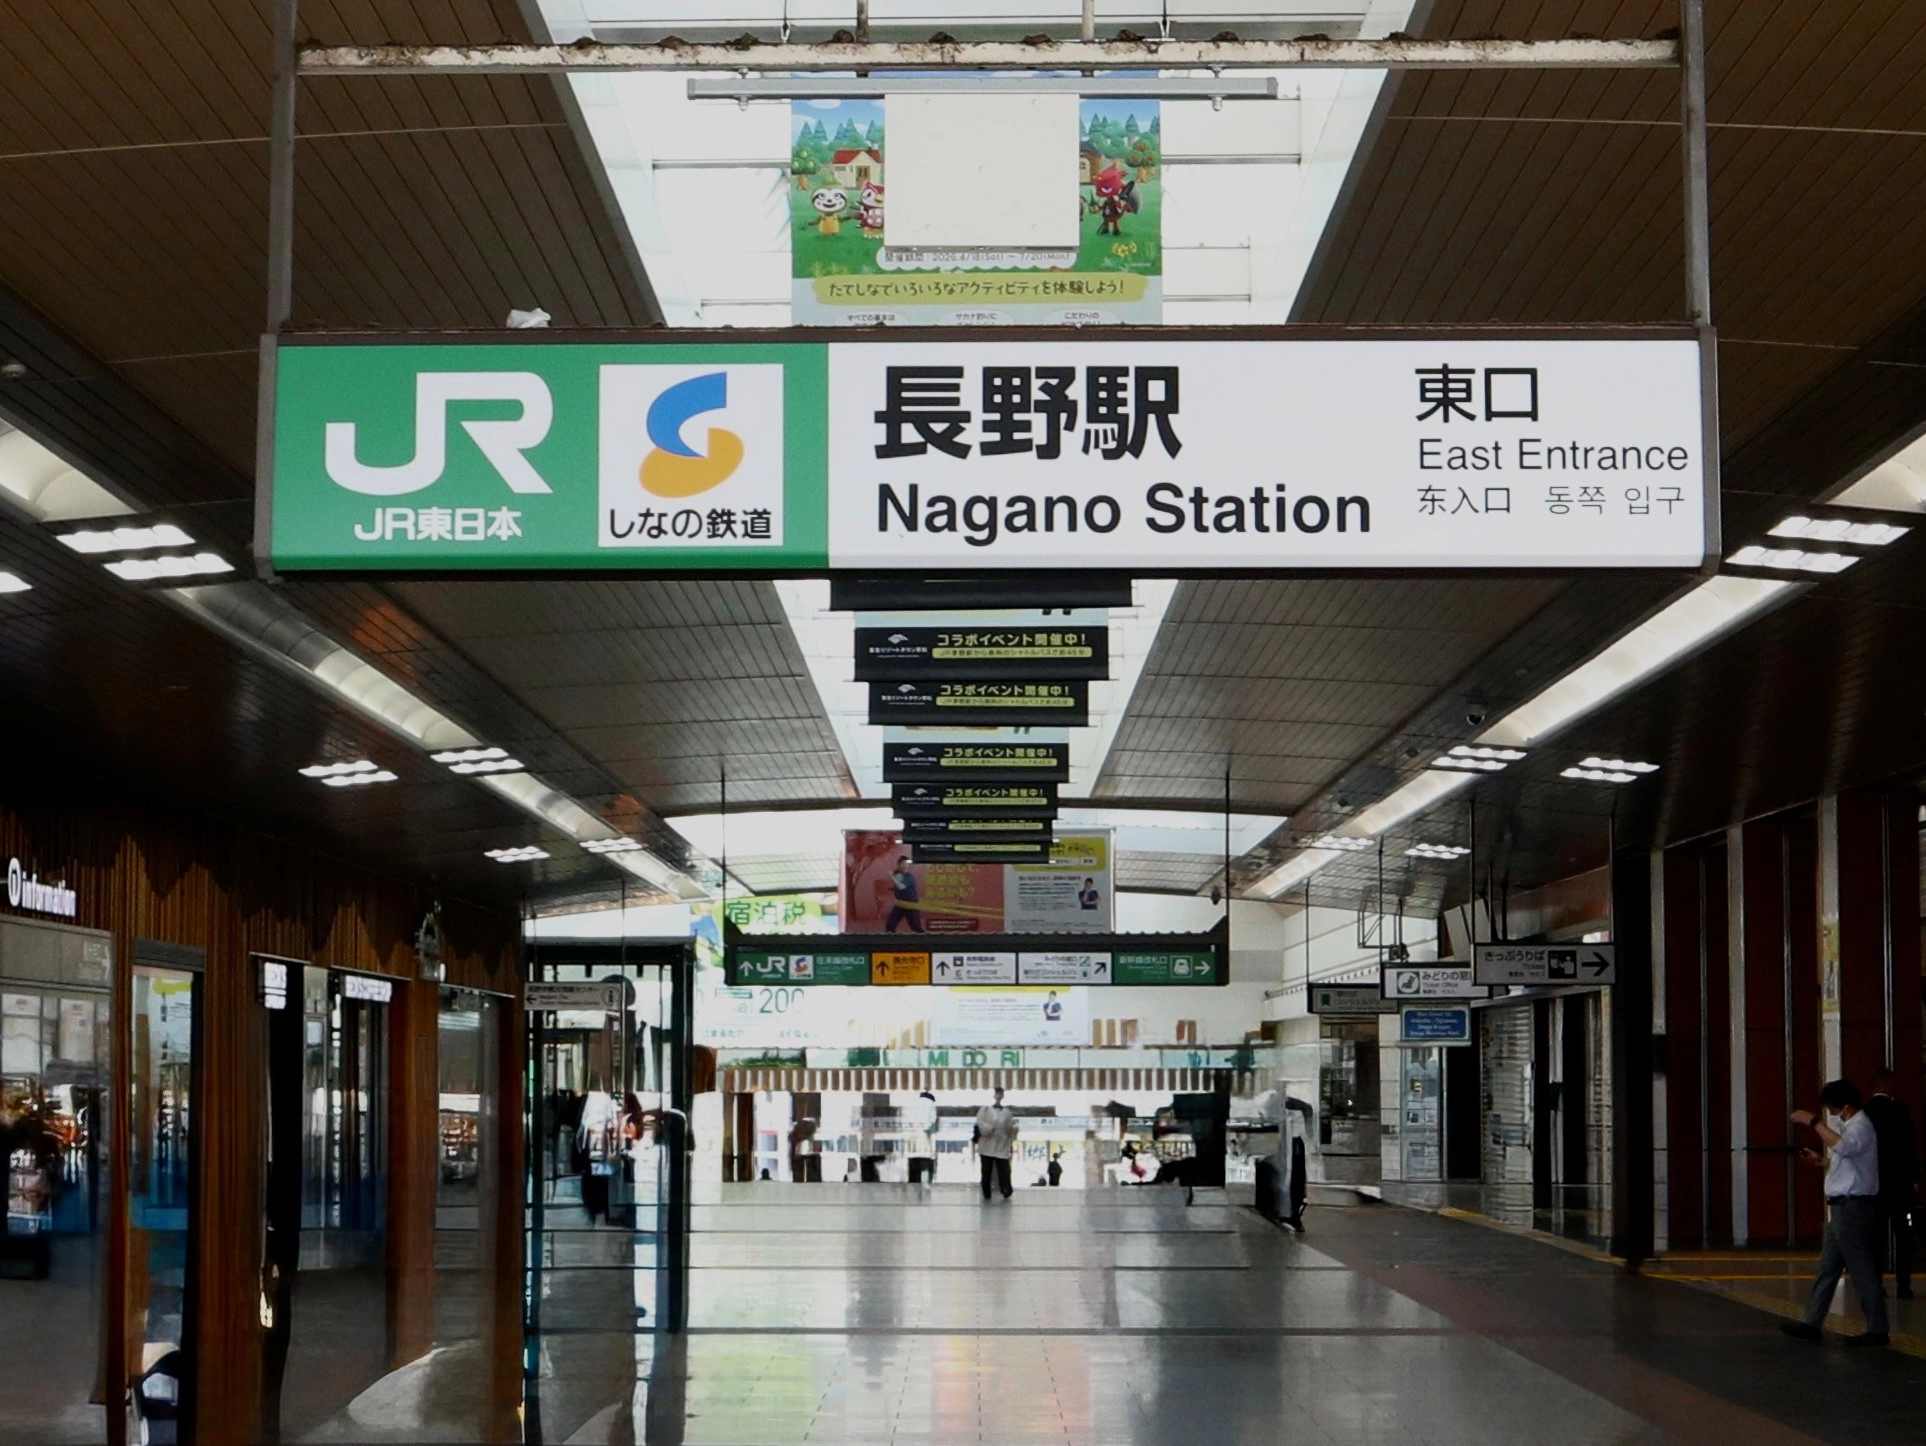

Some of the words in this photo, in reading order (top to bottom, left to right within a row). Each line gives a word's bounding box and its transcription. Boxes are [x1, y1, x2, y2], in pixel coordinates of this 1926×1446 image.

[829, 280, 1125, 298] たてしなでいろいろなアクティビティを体験しよう！
[1415, 363, 1539, 423] 東口
[874, 365, 1183, 460] 長野駅
[325, 371, 554, 496] JR
[1419, 439, 1503, 471] East
[1518, 439, 1689, 472] Entrance
[877, 482, 1122, 547] Nagano
[1145, 482, 1371, 534] Station
[1417, 484, 1512, 515] 东入口
[1544, 485, 1607, 515] 동쪽
[1624, 485, 1685, 515] 입구
[354, 506, 523, 541] JR東日本
[608, 507, 773, 540] しなの鉄道
[726, 900, 806, 925] 宿泊税
[756, 956, 787, 973] JR
[1484, 950, 1546, 962] きっぷうりば
